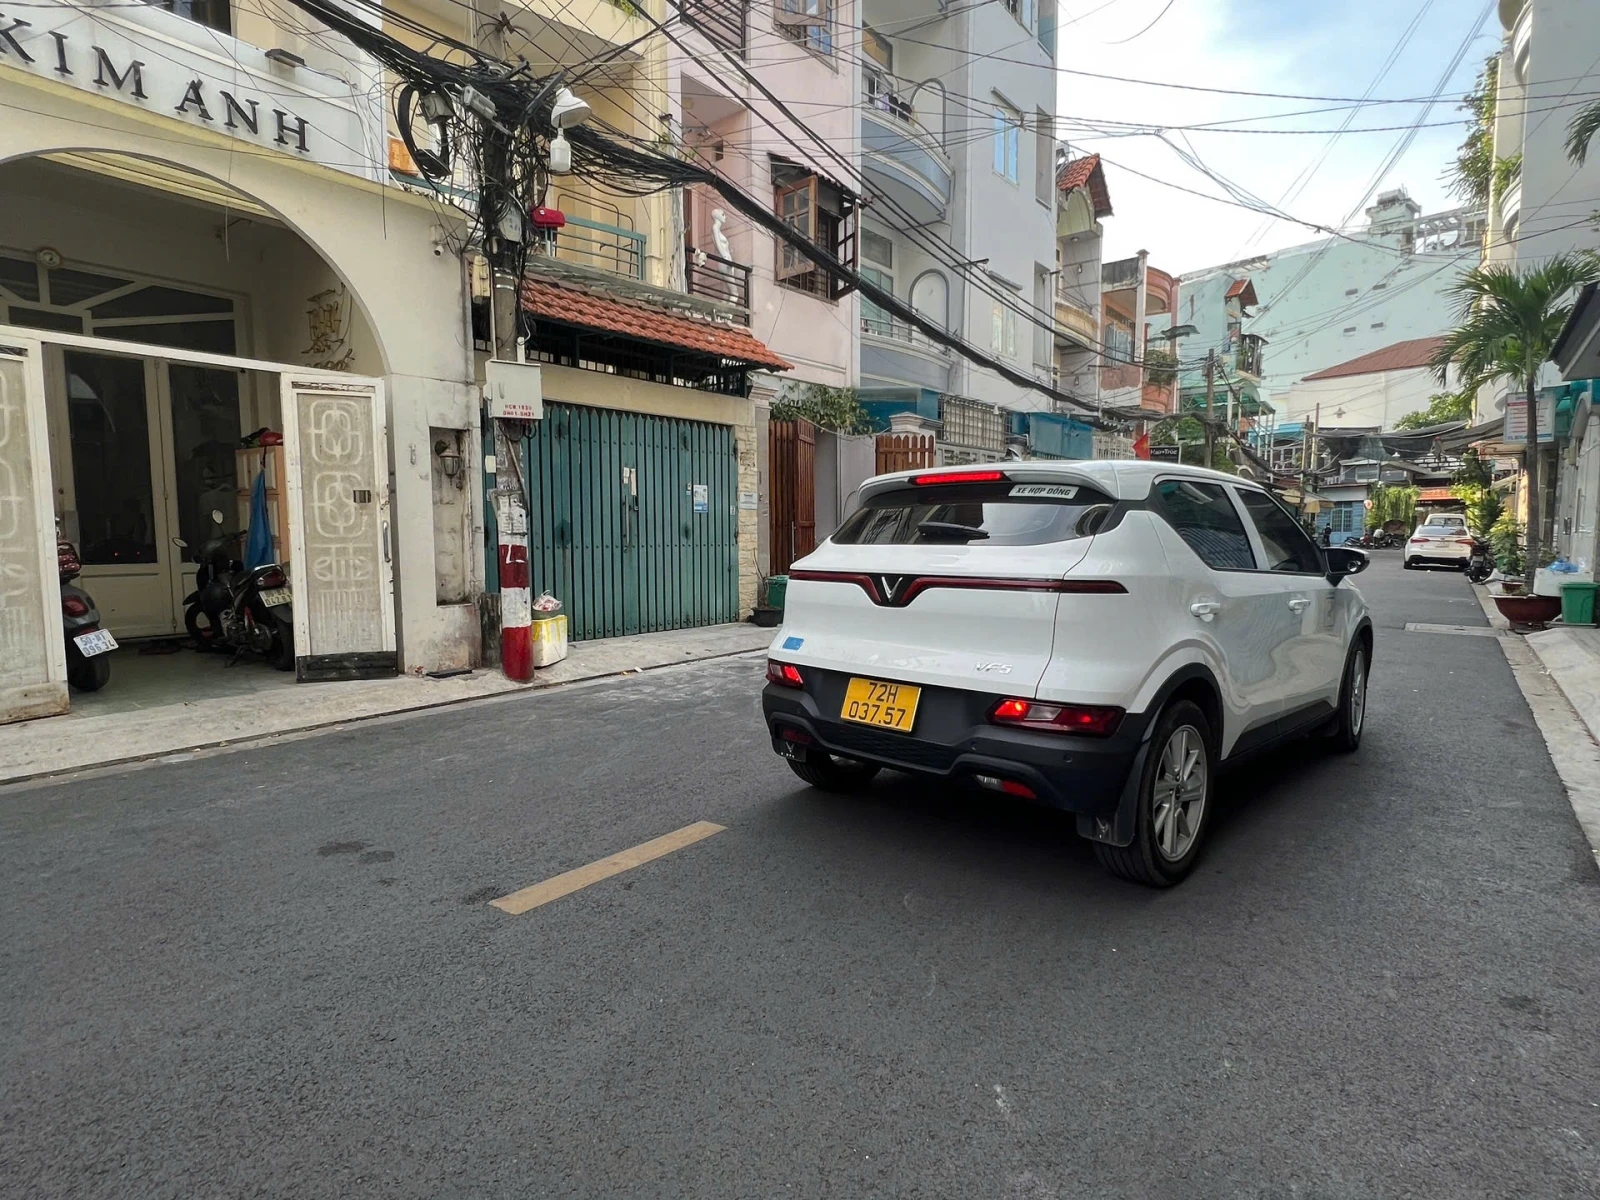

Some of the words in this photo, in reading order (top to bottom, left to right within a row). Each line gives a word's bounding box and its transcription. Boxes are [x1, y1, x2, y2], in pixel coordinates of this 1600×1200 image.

[0, 12, 149, 99] KIM
[867, 682, 899, 704] 72H
[848, 700, 907, 727] 037.57
